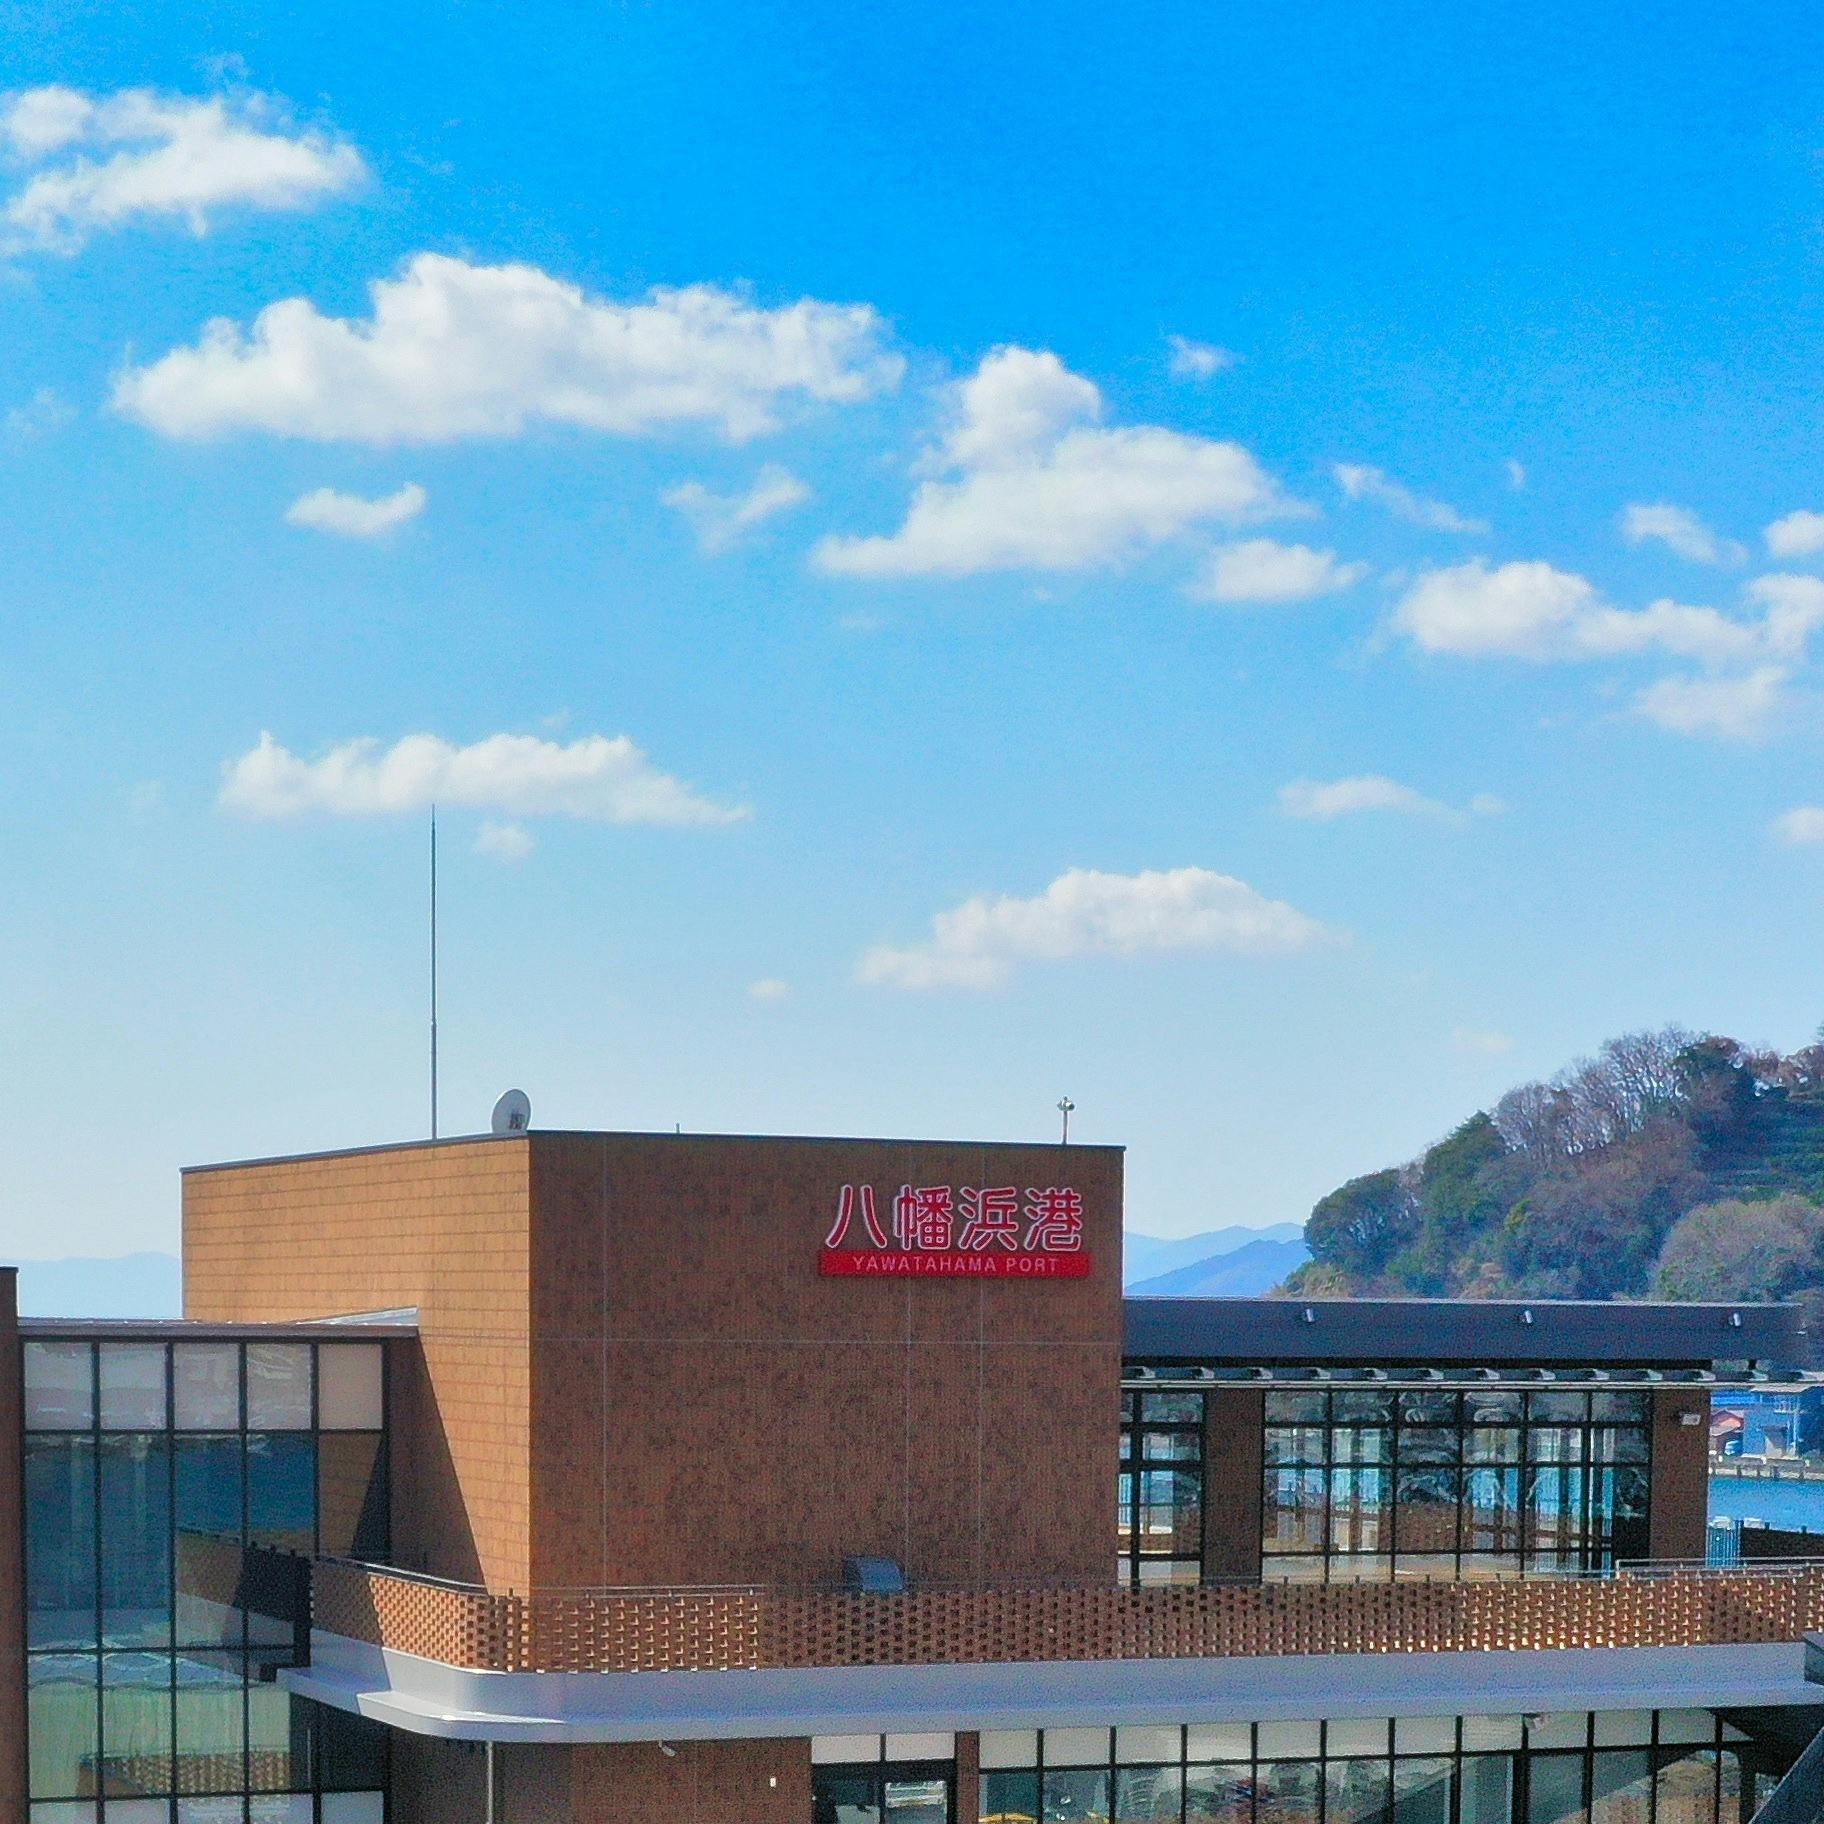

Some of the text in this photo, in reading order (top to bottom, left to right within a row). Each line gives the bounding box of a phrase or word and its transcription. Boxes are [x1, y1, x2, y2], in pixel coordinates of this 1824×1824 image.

[826, 1184, 1082, 1251] 八幡浜港
[852, 1255, 1059, 1272] YAWATAHAMA PORT
